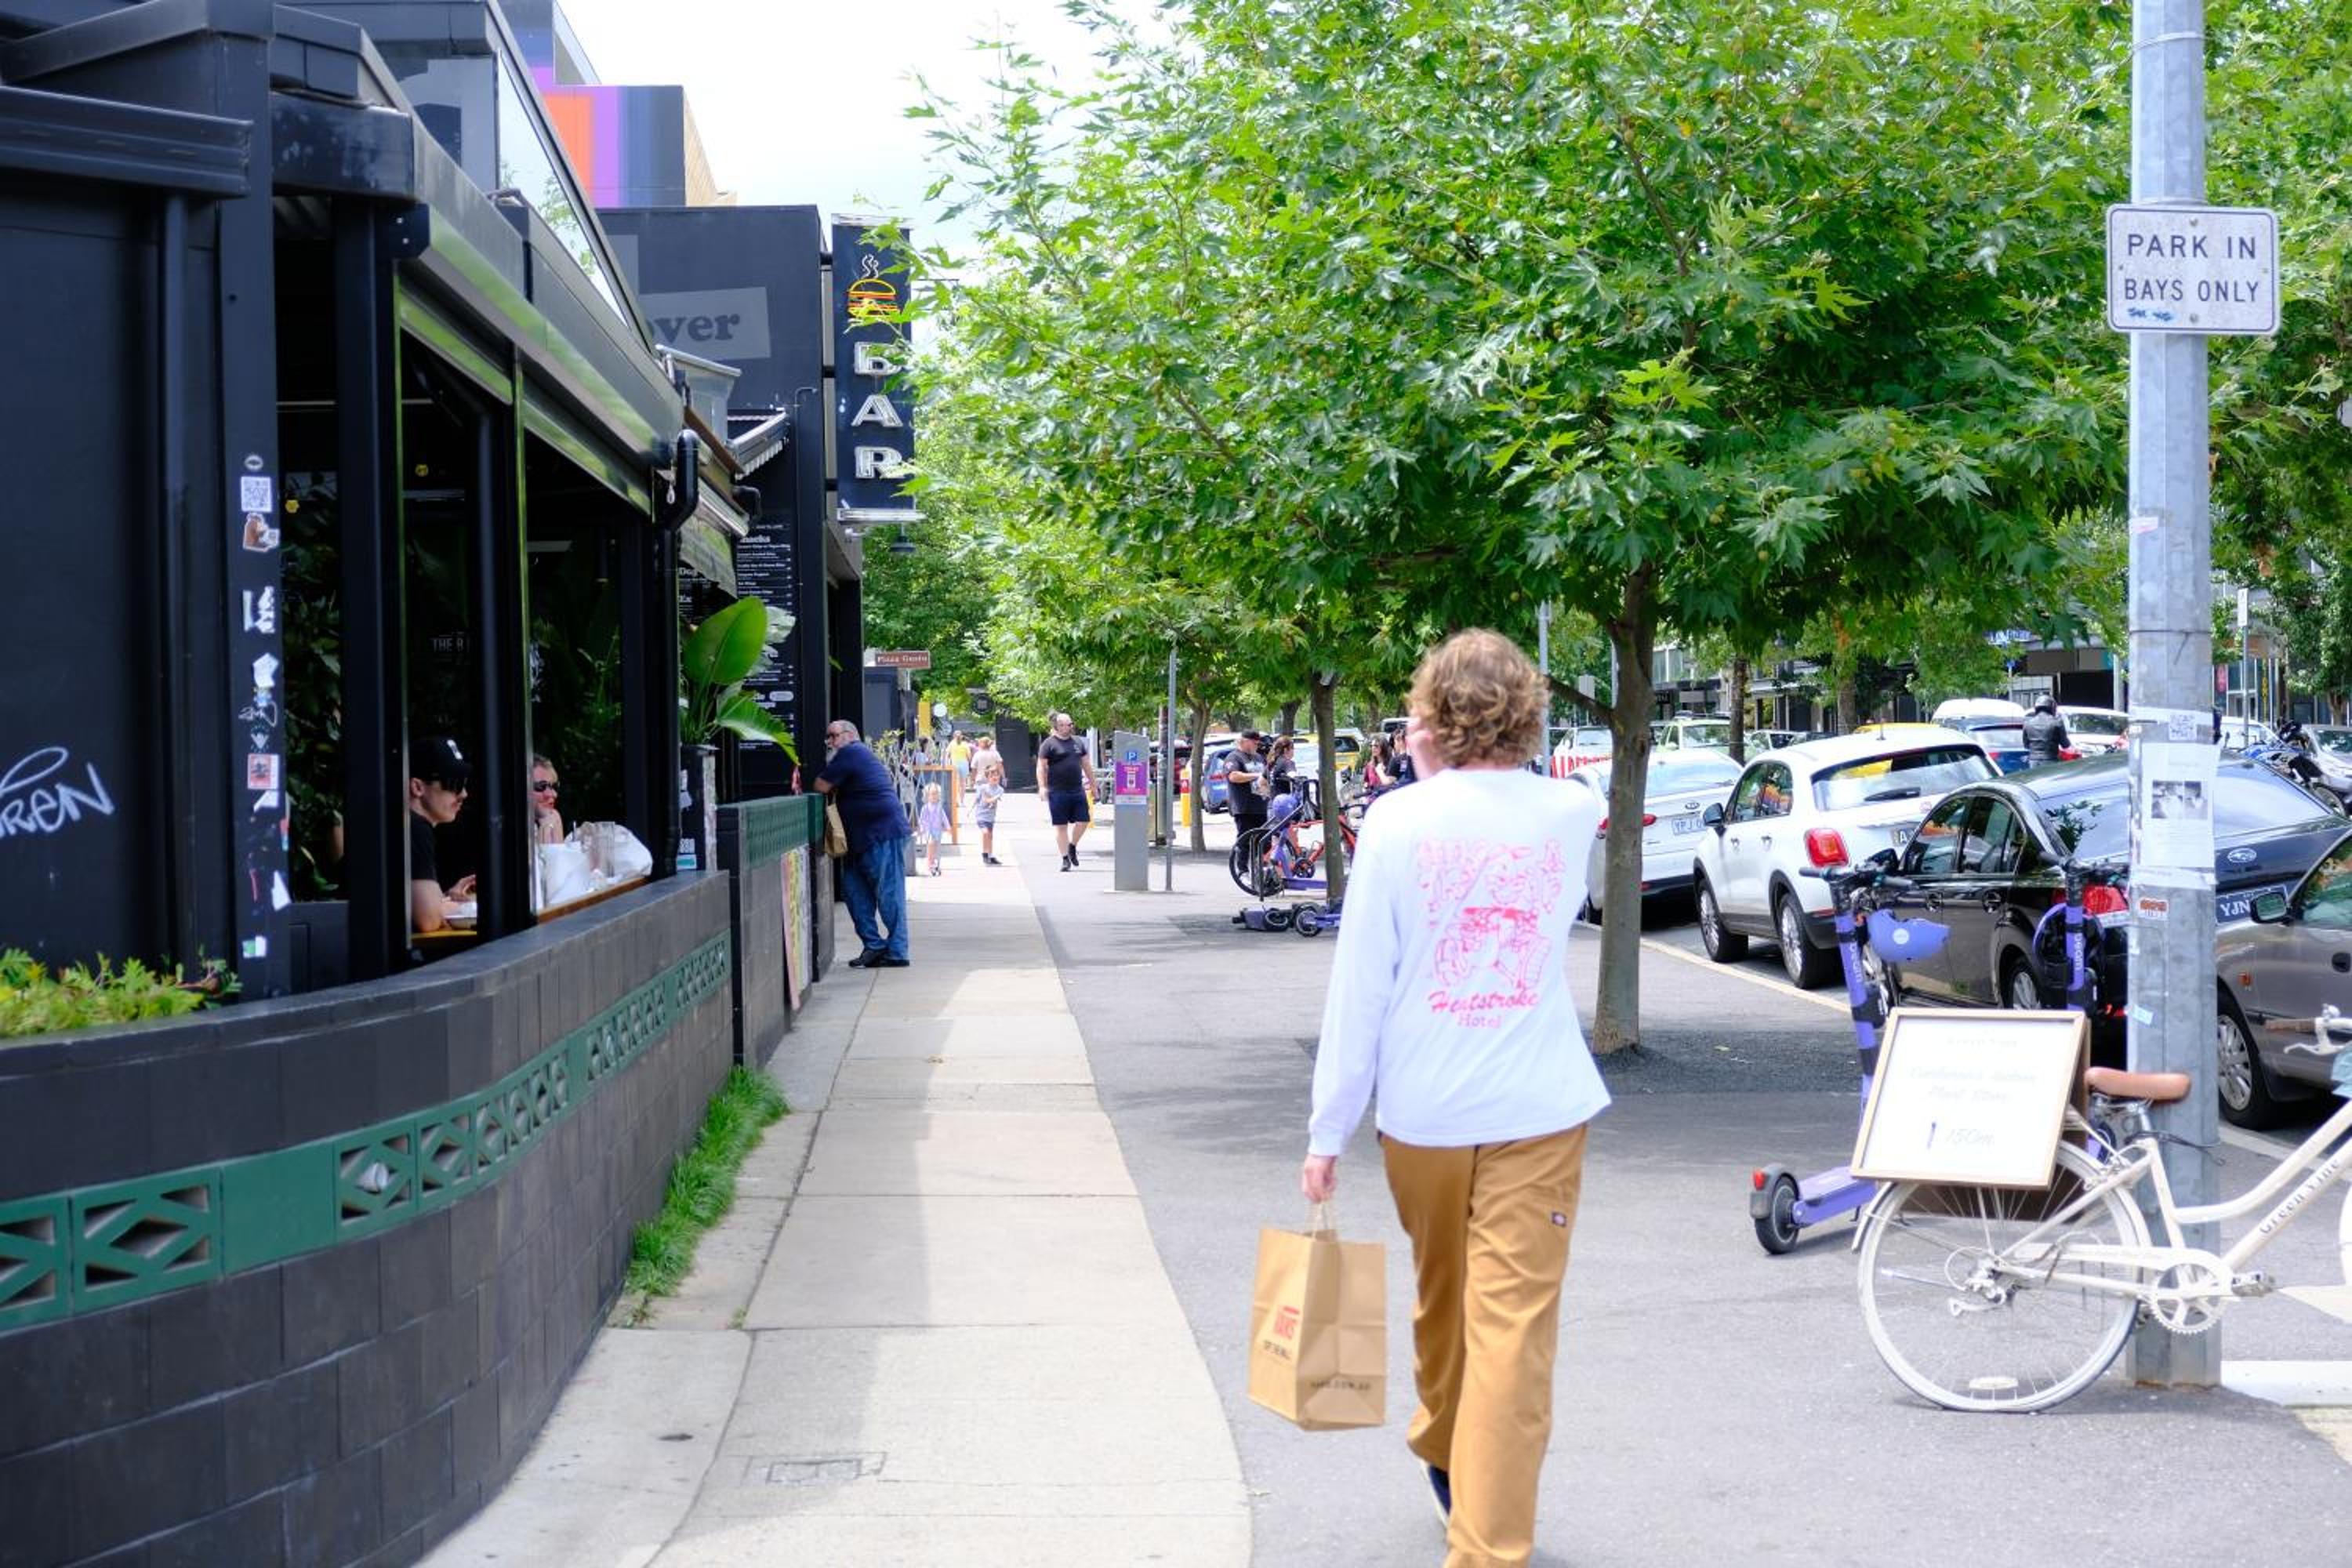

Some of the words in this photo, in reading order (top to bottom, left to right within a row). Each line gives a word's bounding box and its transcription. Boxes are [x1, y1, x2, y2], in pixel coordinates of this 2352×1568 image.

[2127, 234, 2209, 259] PARK
[2227, 235, 2256, 260] IN
[2125, 278, 2183, 302] BAYS
[2197, 280, 2259, 303] ONLY
[646, 313, 740, 343] ver
[851, 341, 907, 480] BAR
[2220, 899, 2251, 916] YJN
[1457, 1014, 1502, 1029] Hotel
